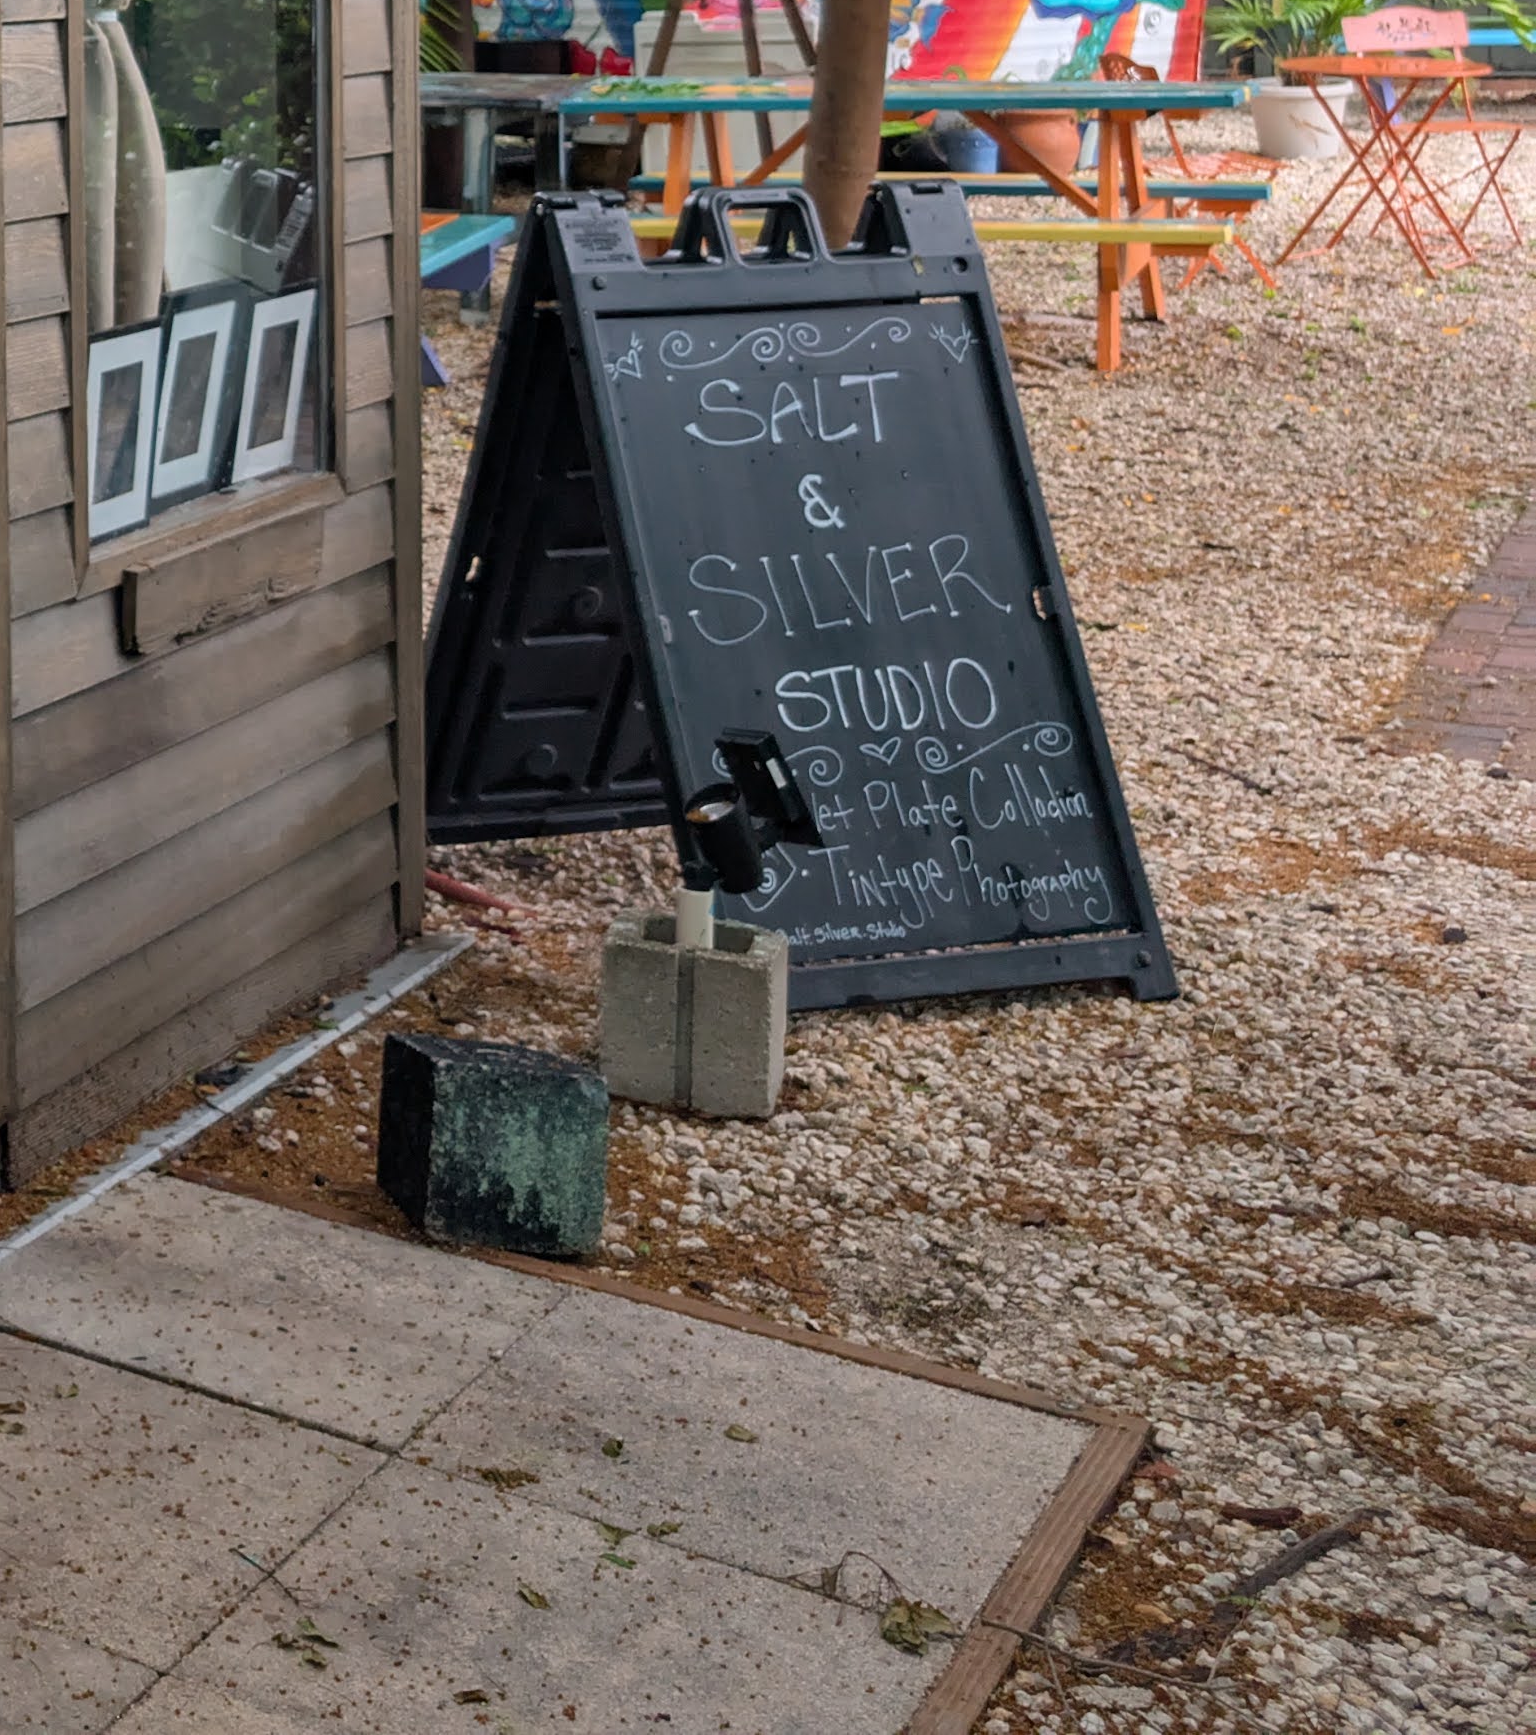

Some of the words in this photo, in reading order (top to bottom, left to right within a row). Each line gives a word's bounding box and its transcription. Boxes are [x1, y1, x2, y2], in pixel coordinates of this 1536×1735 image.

[683, 372, 899, 447] SALT
[798, 473, 846, 530] &
[687, 533, 1012, 645] SILVER
[774, 656, 996, 733] STUDIO
[811, 791, 856, 834] et
[863, 778, 964, 831] Plate
